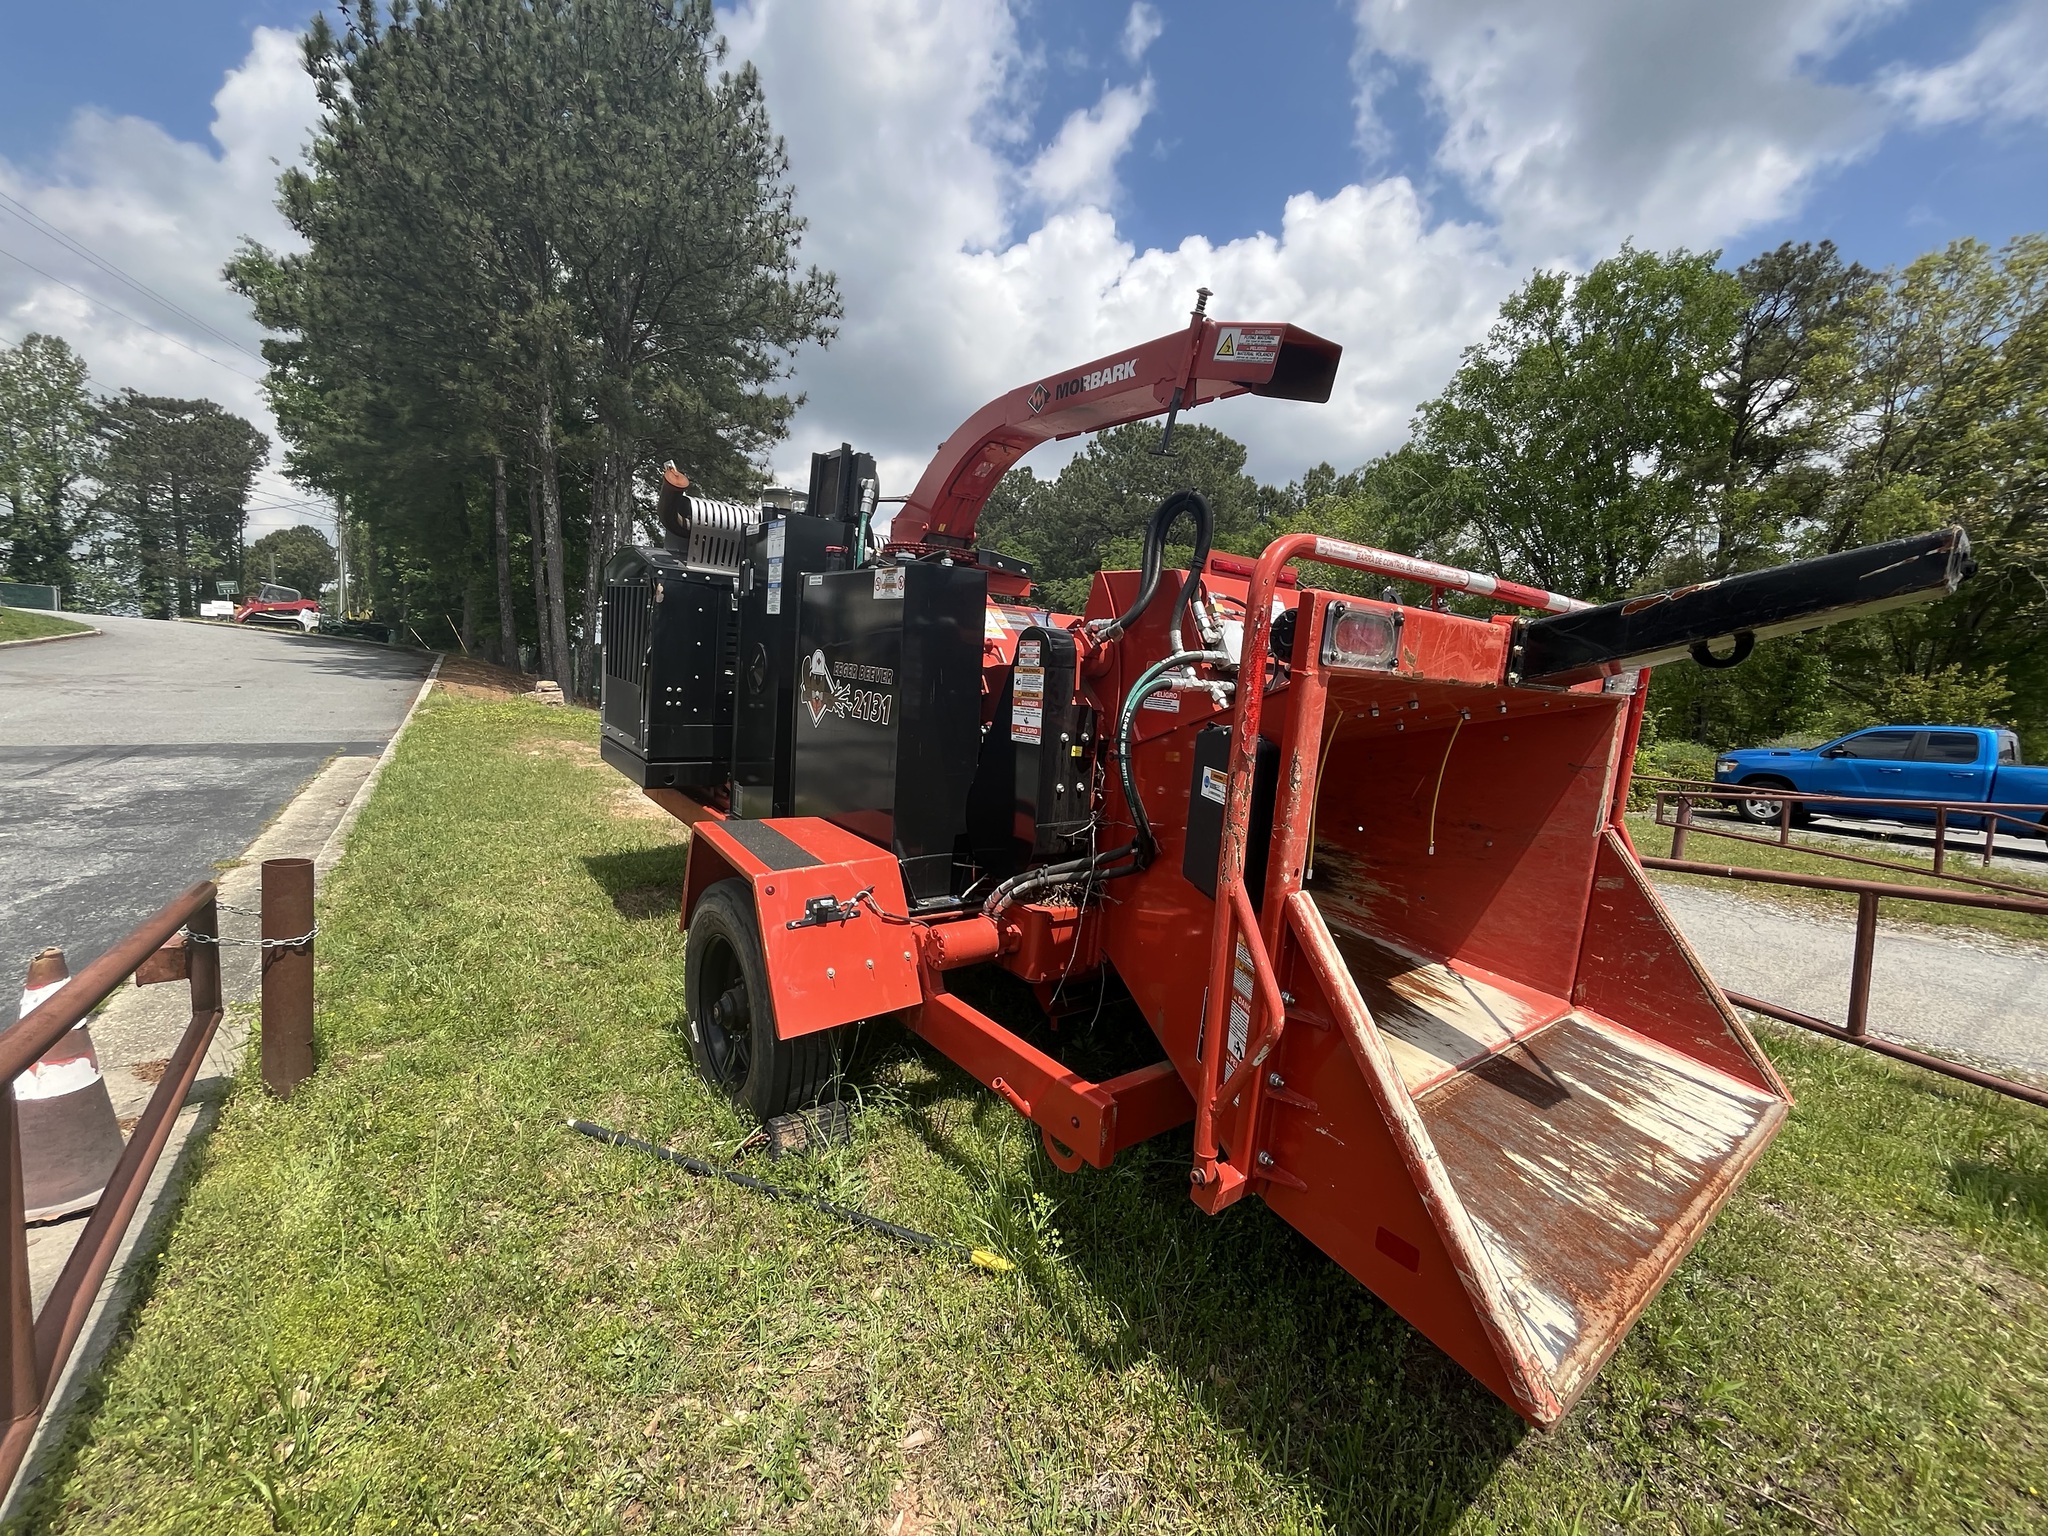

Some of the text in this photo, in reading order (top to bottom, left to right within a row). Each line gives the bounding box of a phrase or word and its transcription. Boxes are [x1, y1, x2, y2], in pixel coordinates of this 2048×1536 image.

[1056, 360, 1138, 400] MORBARK
[1374, 556, 1383, 565] DE
[1383, 558, 1405, 571] CONTROL
[858, 665, 894, 685] BEEVER
[851, 689, 892, 725] 2131
[1020, 726, 1038, 735] PELIGRO
